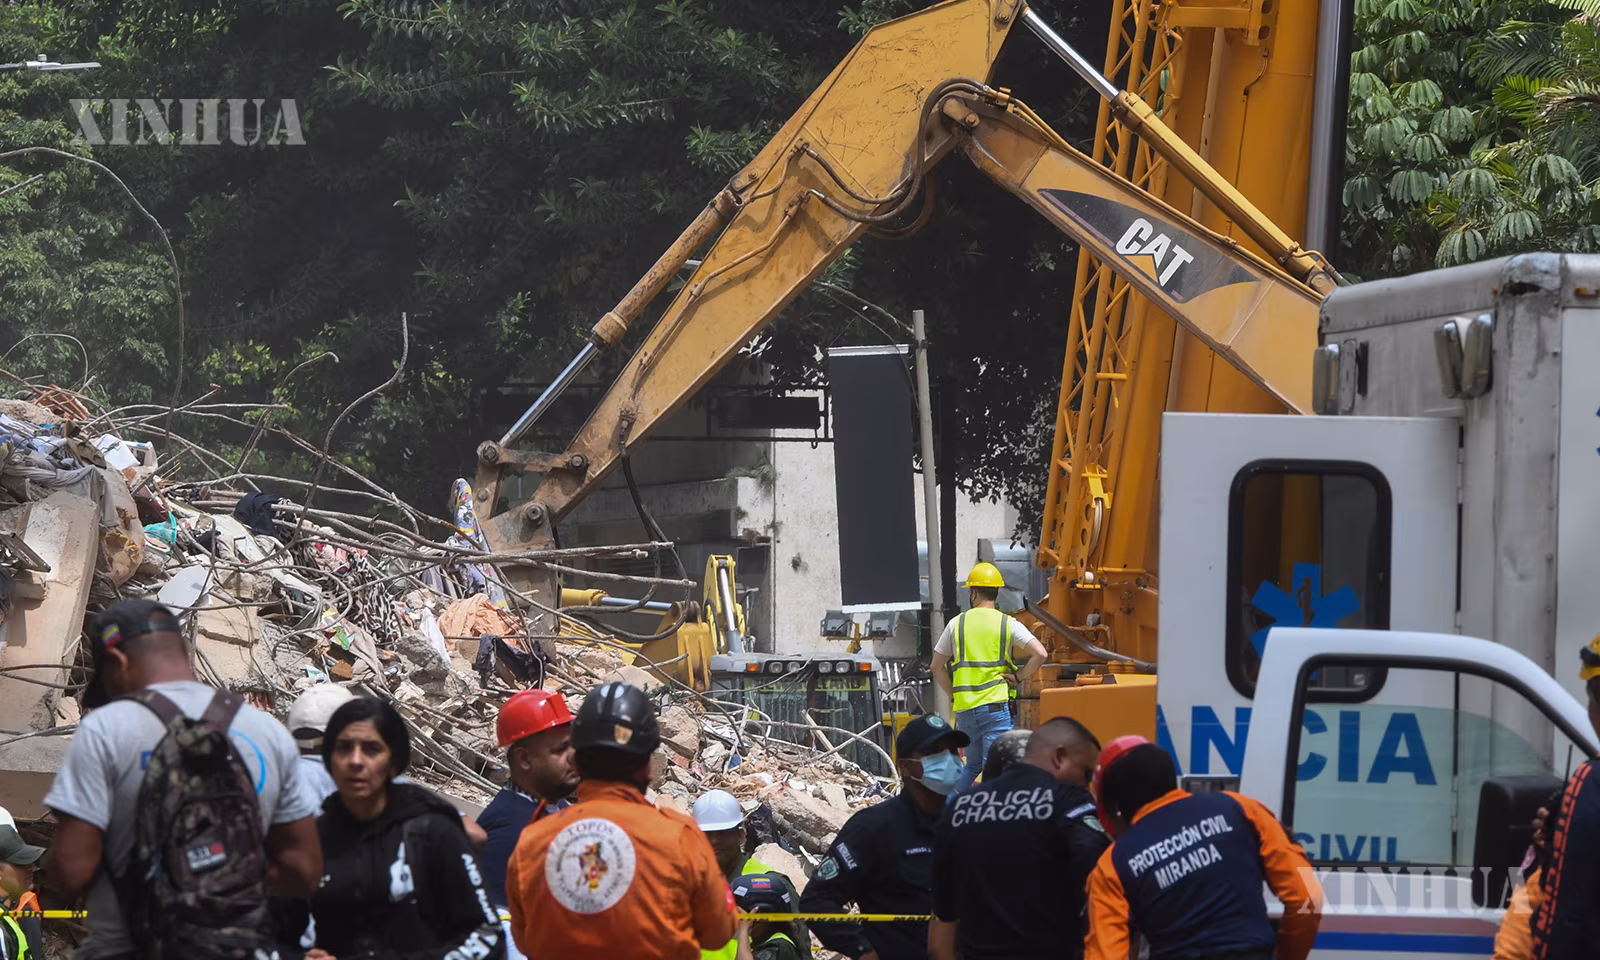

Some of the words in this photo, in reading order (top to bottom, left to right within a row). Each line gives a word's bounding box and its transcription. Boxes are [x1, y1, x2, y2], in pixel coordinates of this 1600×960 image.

[1116, 218, 1194, 287] CAT
[951, 803, 1053, 827] CHACAO
[954, 787, 1054, 810] POLICÍA
[1128, 825, 1202, 878] PROTECCIÓN
[1200, 814, 1233, 838] CIVIL
[1155, 843, 1223, 890] MIRANDA
